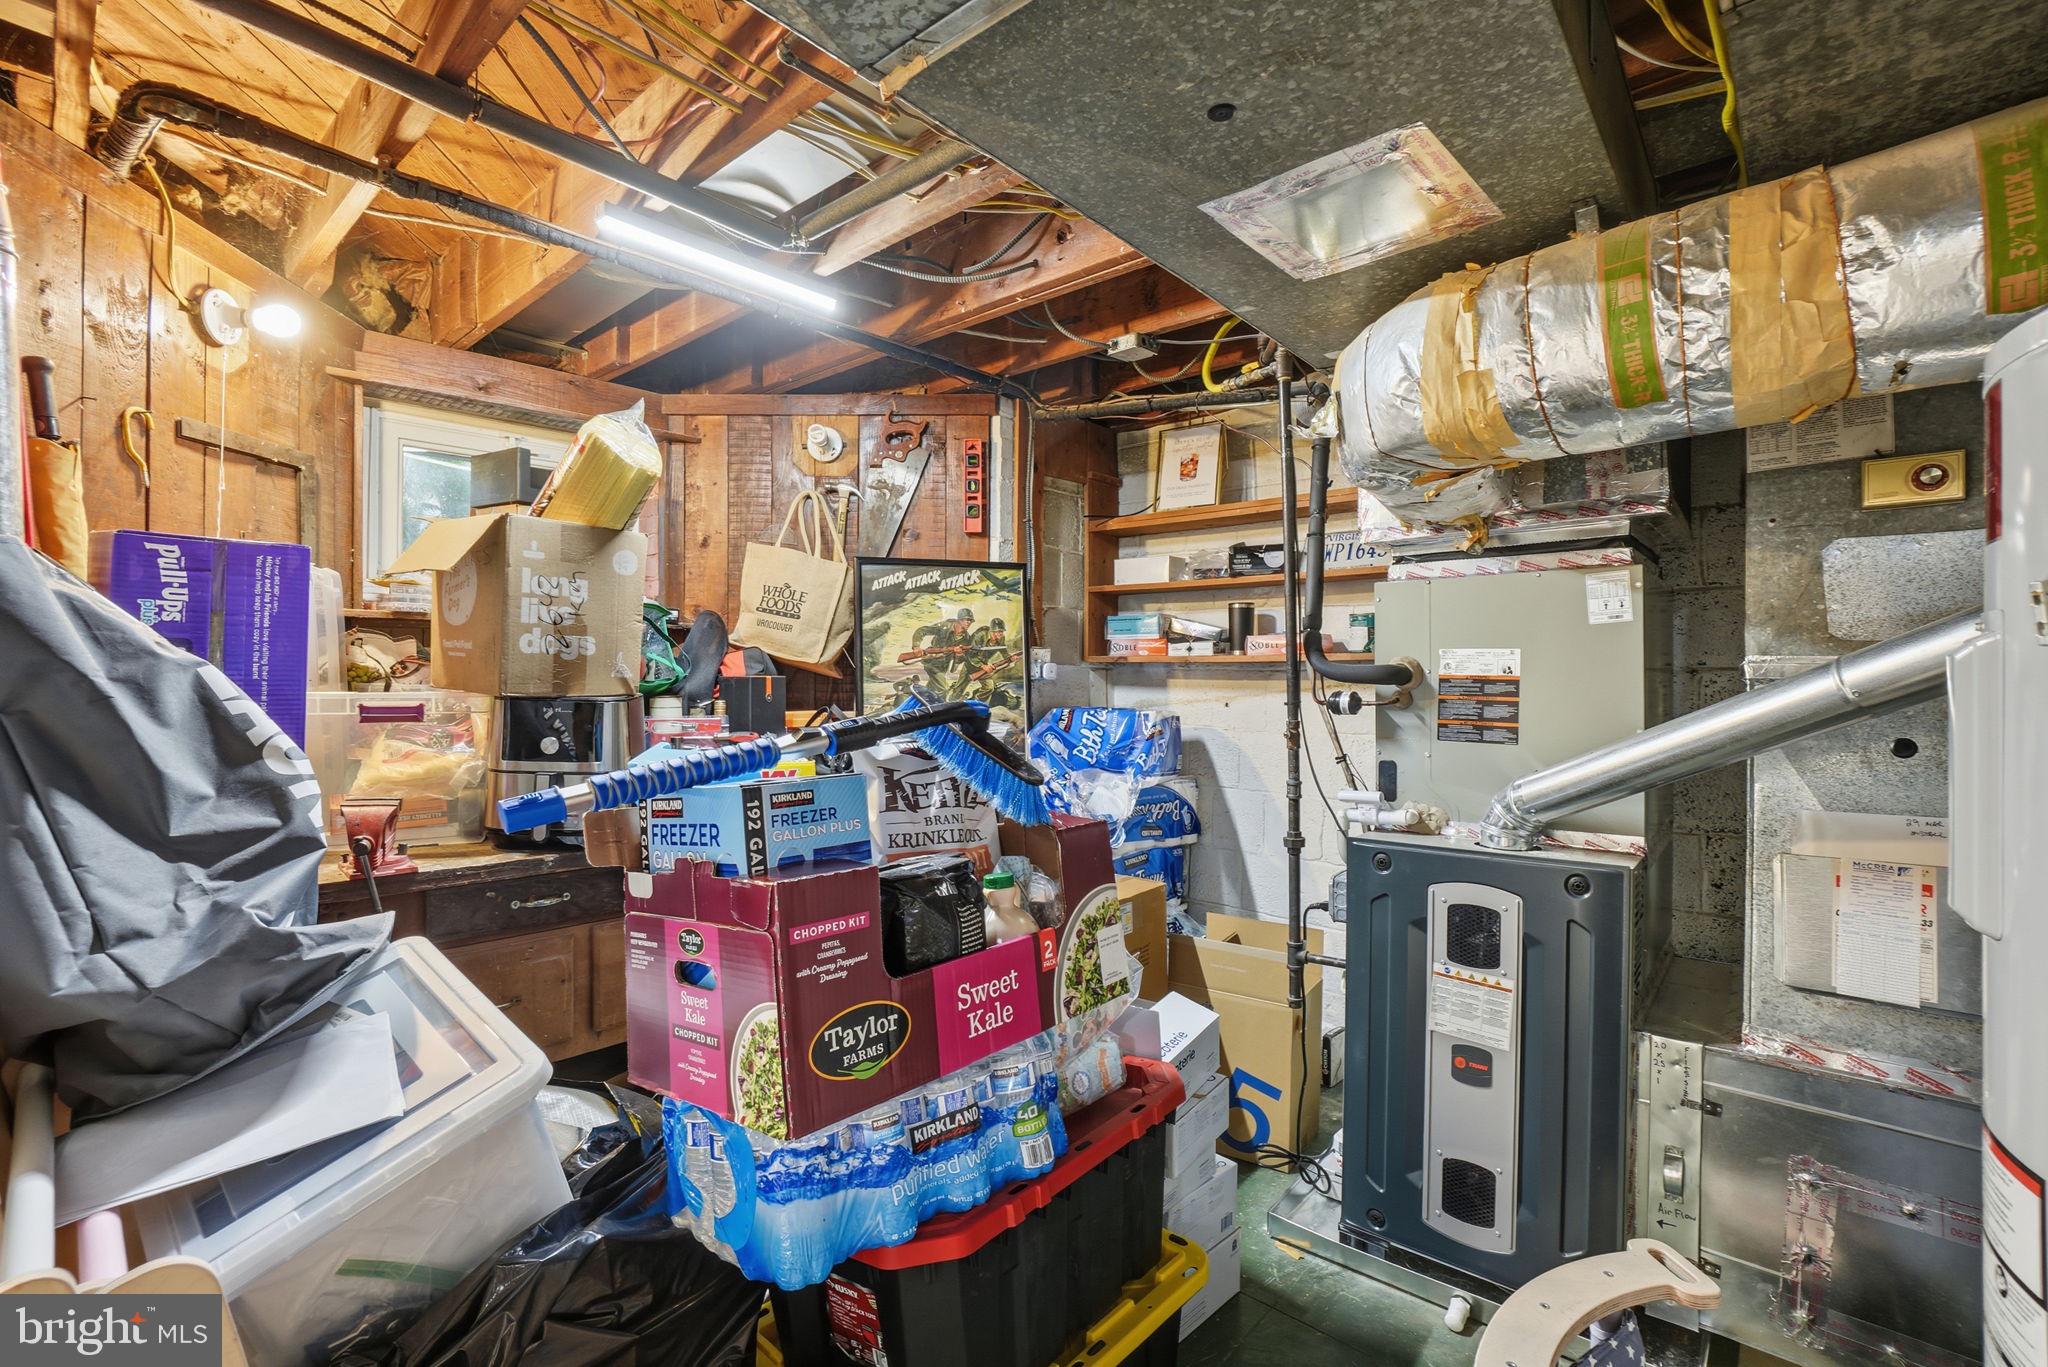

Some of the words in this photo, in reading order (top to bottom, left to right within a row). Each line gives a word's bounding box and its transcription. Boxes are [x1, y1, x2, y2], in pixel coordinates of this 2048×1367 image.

[2007, 168, 2038, 227] THICK
[1622, 338, 1649, 388] THICK
[255, 555, 264, 567] You
[264, 556, 273, 578] Mickey
[254, 580, 262, 594] help
[264, 579, 272, 591] and
[521, 568, 589, 604] long
[872, 570, 907, 591] ATTACK
[905, 569, 941, 591] ATTACK
[938, 569, 980, 591] ATTACK
[253, 596, 261, 610] keep
[264, 592, 272, 602] his
[763, 583, 808, 603] WHOLE
[520, 597, 577, 626] live
[760, 596, 803, 614] FOODS
[253, 611, 261, 627] them
[263, 604, 271, 628] Friends
[756, 618, 793, 632] VANCOUVER
[261, 642, 270, 664] visiting
[519, 628, 597, 661] dogs
[1112, 643, 1137, 652] NOBLE
[1249, 640, 1280, 651] NOBLE
[252, 651, 260, 662] the
[261, 666, 269, 680] their
[261, 681, 269, 701] animal
[652, 799, 683, 811] KIRKLAND
[772, 791, 813, 803] KIRKLAND
[639, 801, 647, 828] 192
[746, 800, 762, 831] 192
[771, 807, 838, 828] FREEZER
[652, 823, 721, 847] FREEZER
[772, 823, 826, 842] GALLON
[830, 819, 862, 833] PLUS
[1852, 861, 1895, 872] McCREA
[793, 920, 846, 940] CHOPPED
[848, 915, 866, 928] KIT
[1043, 940, 1054, 959] 2
[1043, 958, 1057, 968] PACK
[819, 969, 848, 984] Dressing
[956, 968, 1020, 1011] Sweet
[681, 990, 709, 1010] Sweet
[684, 1007, 706, 1026] Kale
[967, 1001, 1014, 1040] Kale
[674, 1027, 706, 1043] CHOPPED
[706, 1036, 719, 1047] KIT
[823, 1013, 899, 1053] Taylor
[843, 1042, 884, 1067] FARMS
[1653, 1041, 1667, 1050] 20
[1653, 1058, 1666, 1068] 25
[1016, 1104, 1038, 1121] 40
[913, 1105, 980, 1144] KIRKLAND
[891, 1154, 961, 1206] purified
[966, 1128, 1005, 1169] water
[1658, 1202, 1673, 1215] Air
